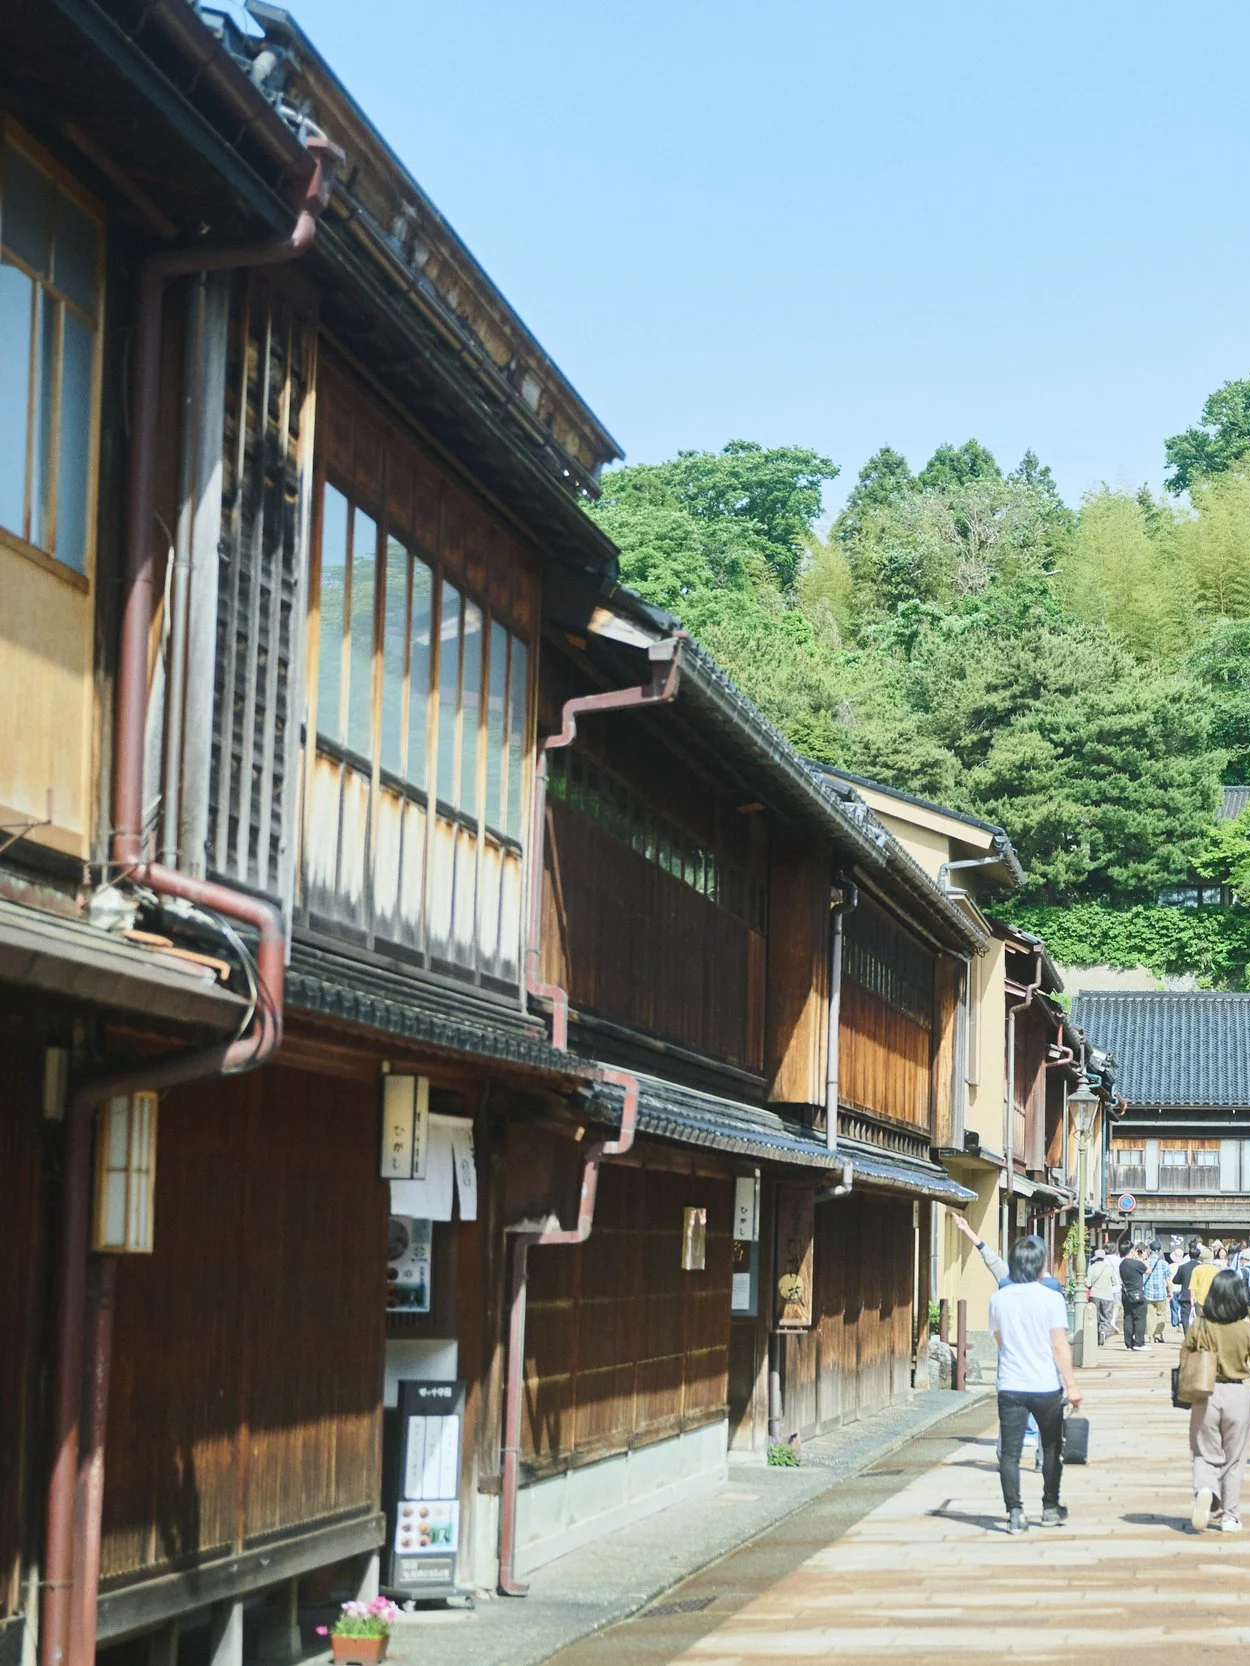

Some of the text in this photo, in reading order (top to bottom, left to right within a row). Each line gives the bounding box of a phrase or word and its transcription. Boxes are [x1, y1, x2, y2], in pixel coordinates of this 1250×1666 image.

[393, 1125, 405, 1170] ひがし
[740, 1206, 748, 1235] ひがし
